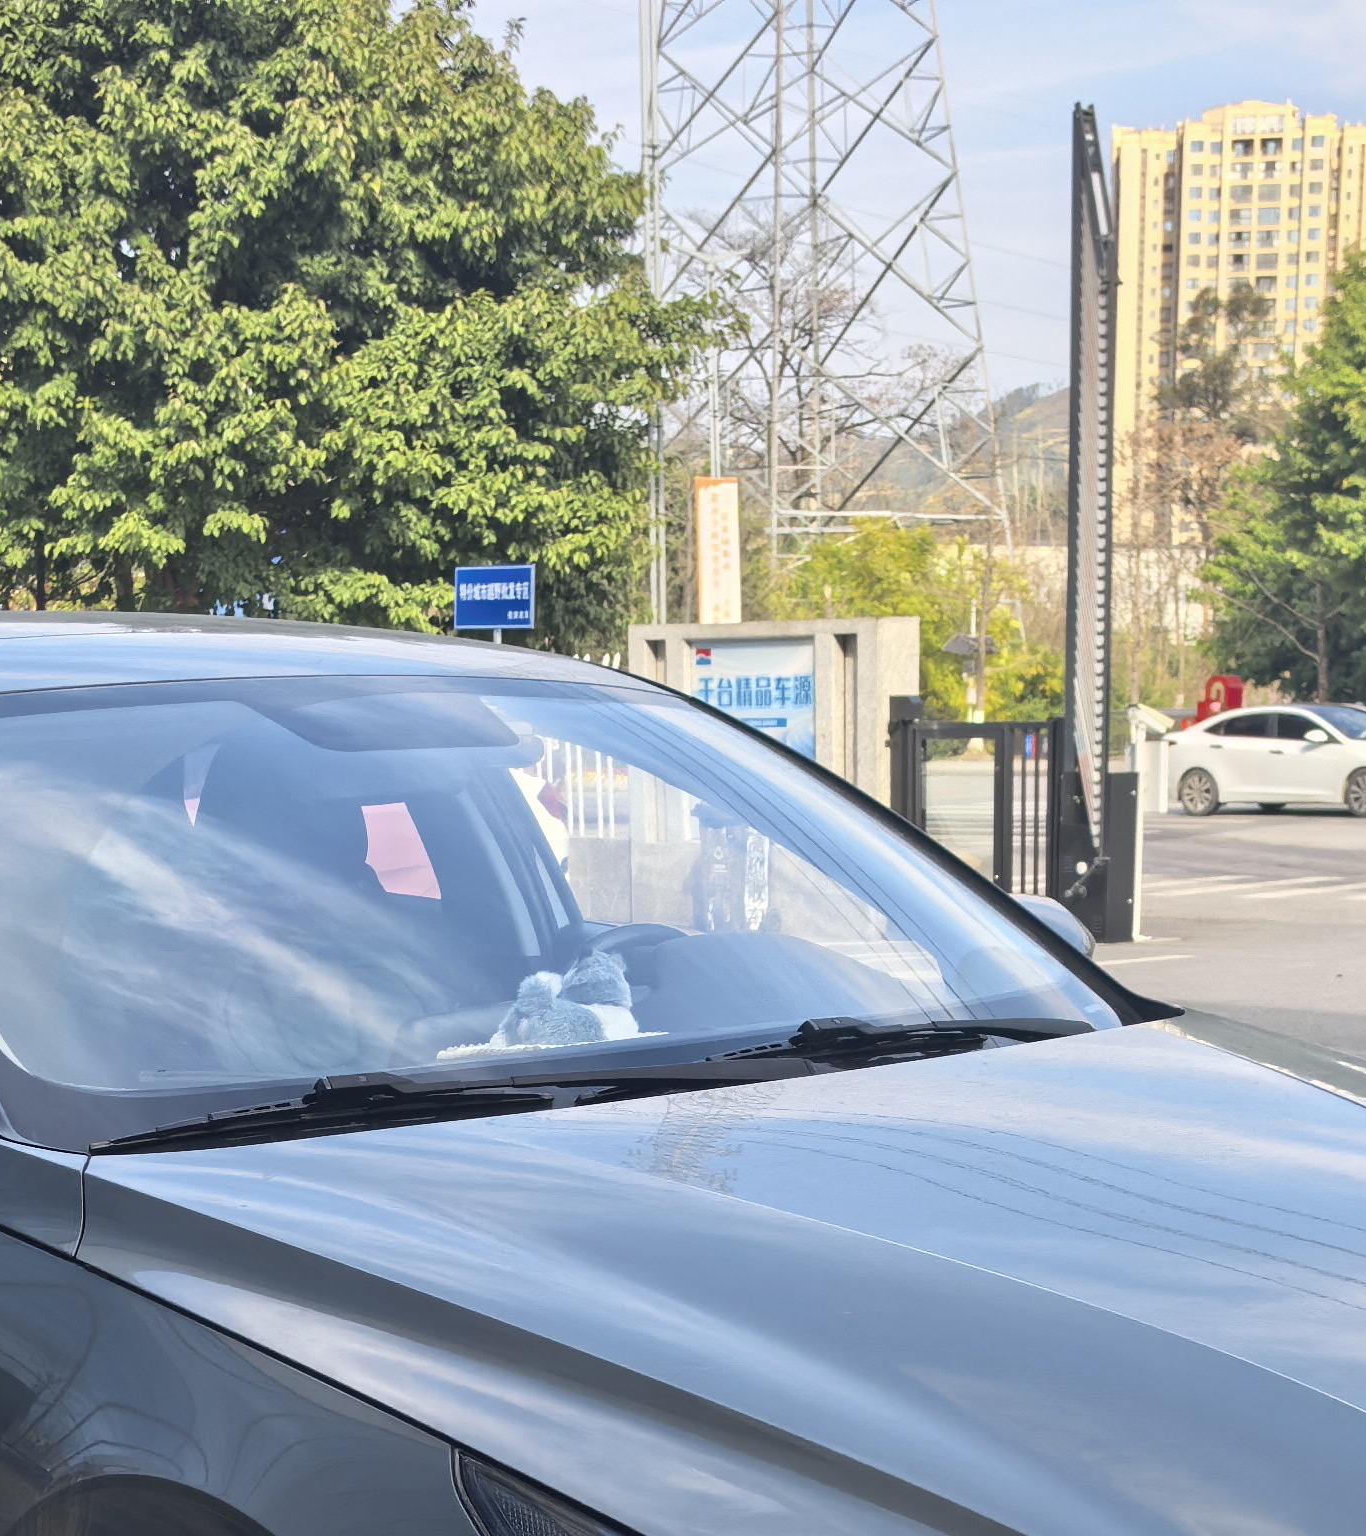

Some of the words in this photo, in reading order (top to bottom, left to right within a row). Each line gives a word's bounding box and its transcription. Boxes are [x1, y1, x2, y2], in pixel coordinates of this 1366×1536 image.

[697, 675, 812, 708] 千台精品车源
